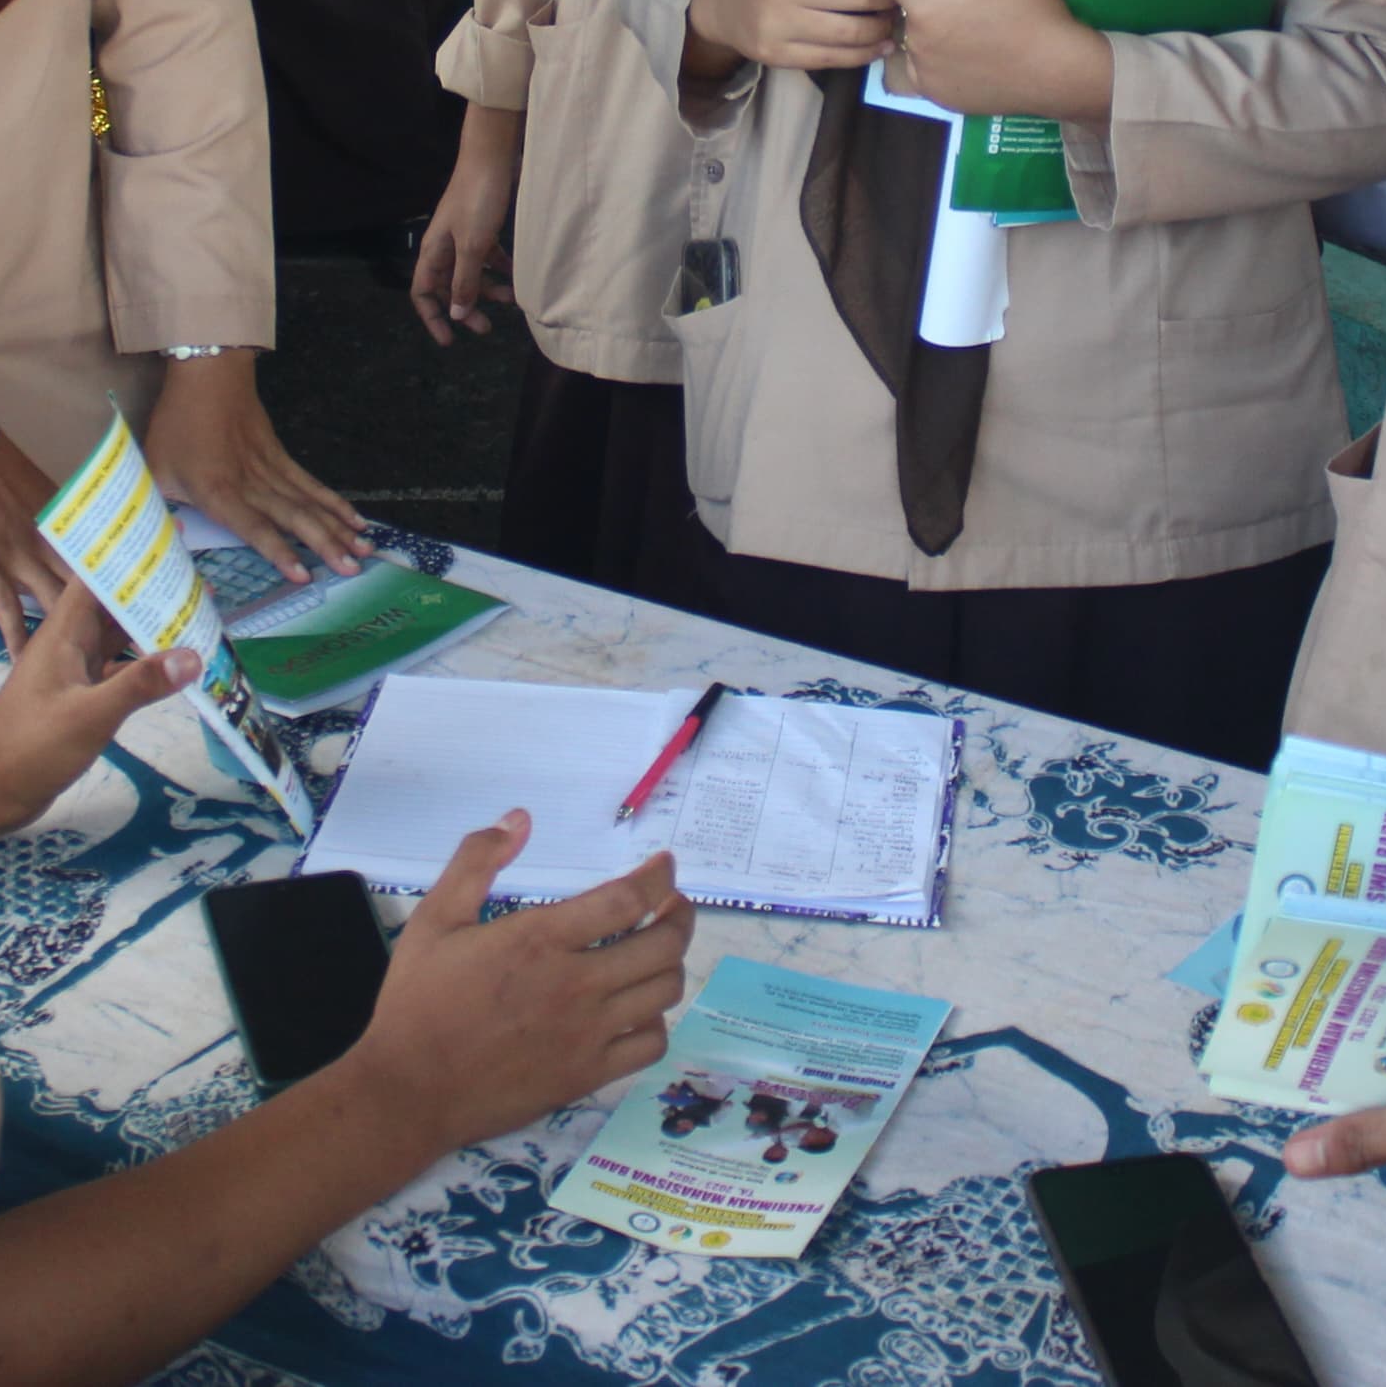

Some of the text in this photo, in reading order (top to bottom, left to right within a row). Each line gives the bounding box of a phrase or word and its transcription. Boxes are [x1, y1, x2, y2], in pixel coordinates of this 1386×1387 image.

[587, 1156, 630, 1179] BARU
[632, 1169, 724, 1204] MAHASISWA
[728, 1197, 824, 1213] PENERIMAAN
